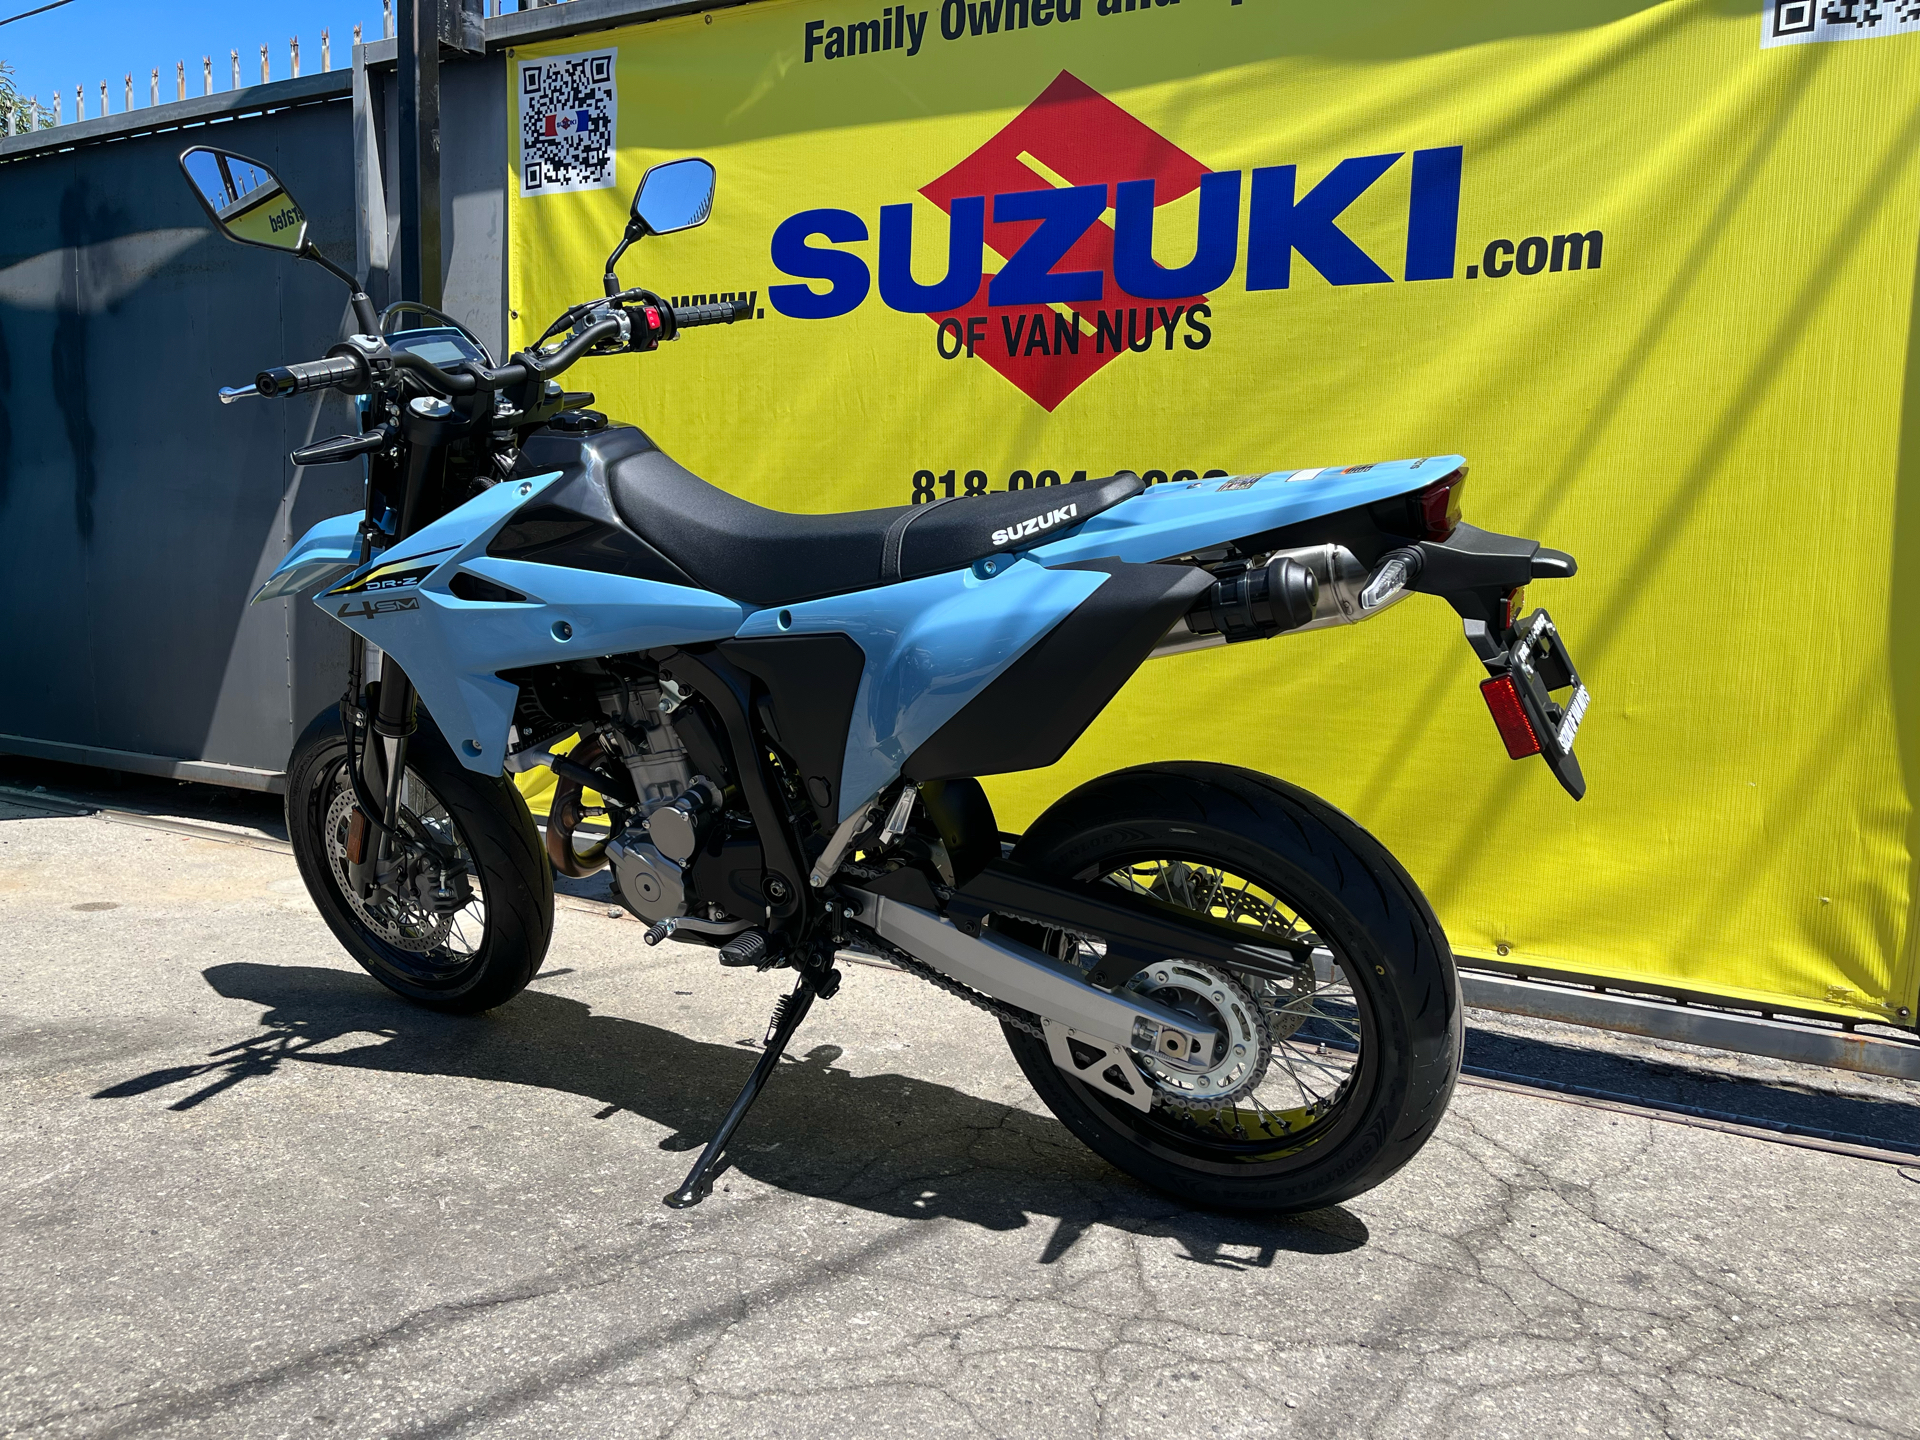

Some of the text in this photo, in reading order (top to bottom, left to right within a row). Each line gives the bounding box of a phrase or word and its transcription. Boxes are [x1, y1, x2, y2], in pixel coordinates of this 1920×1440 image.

[804, 4, 928, 63] Family
[937, 303, 1212, 360] OF VAN NUYS
[991, 503, 1077, 546] SUZUKI
[366, 577, 418, 590] DR-Z
